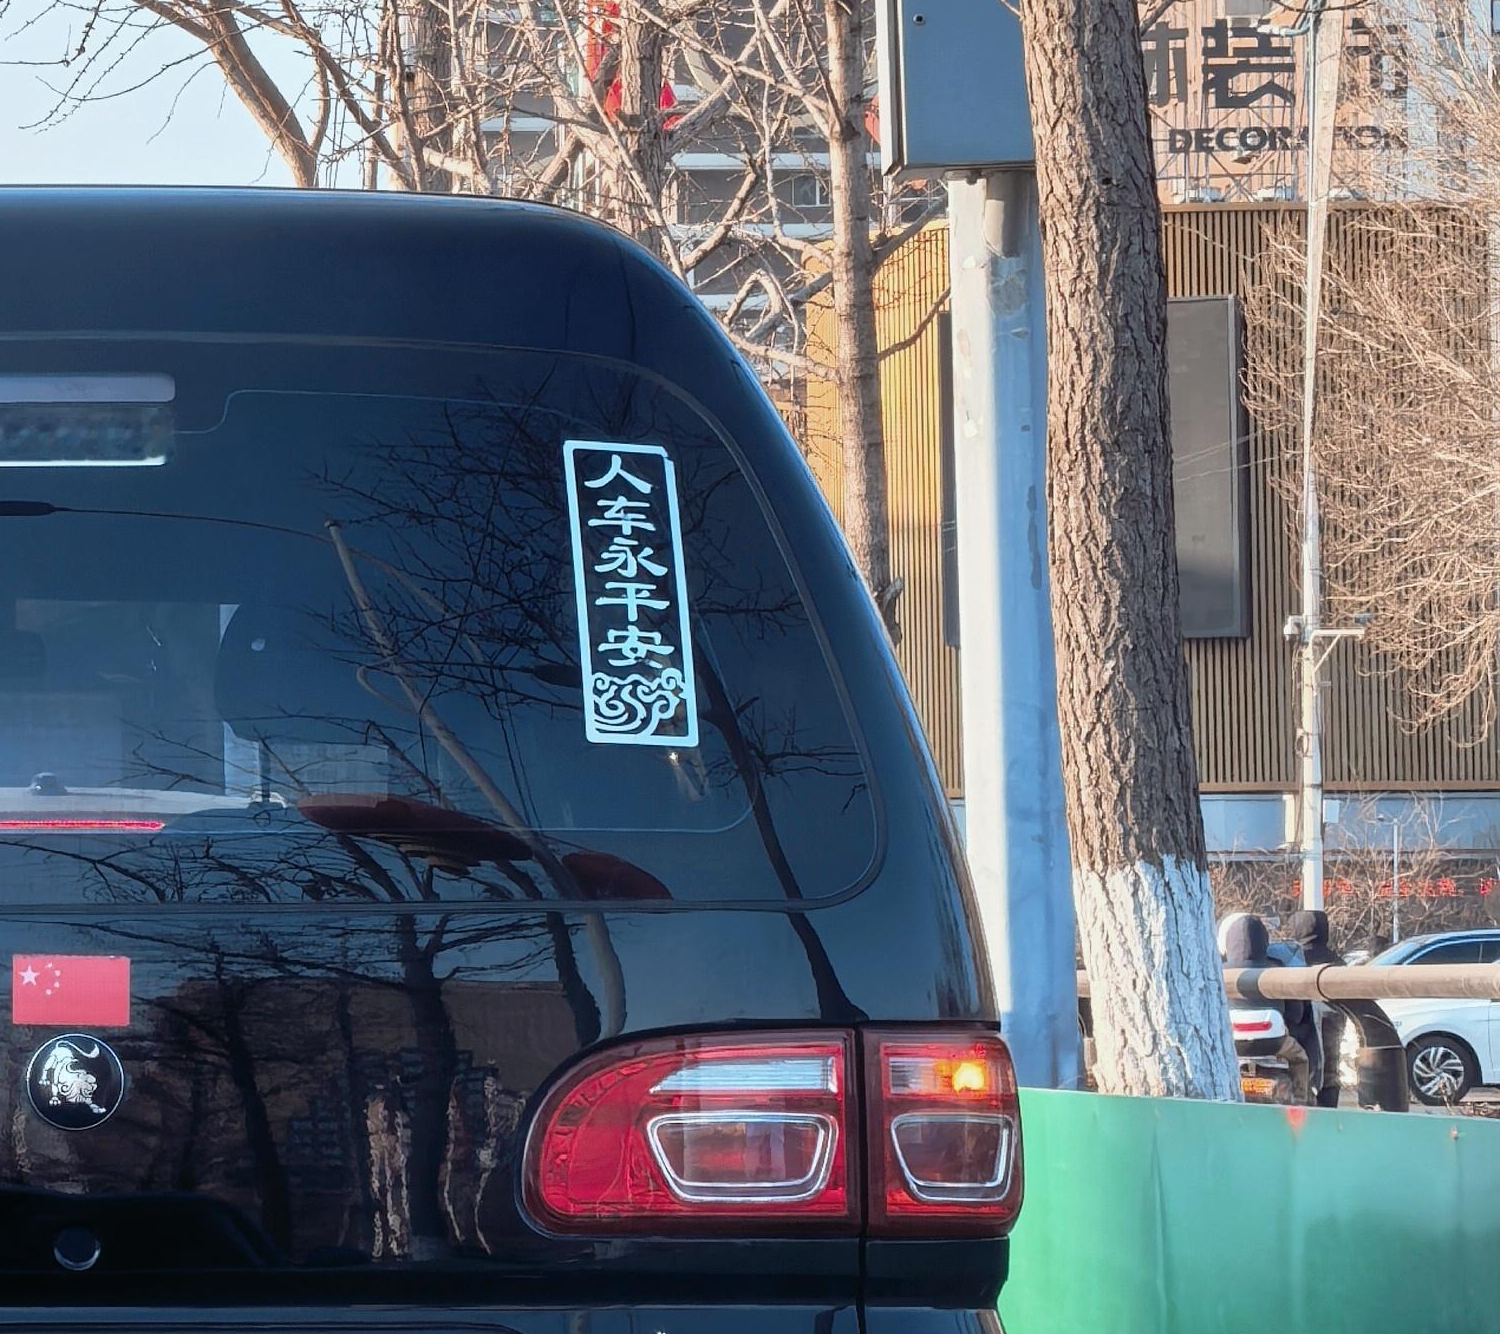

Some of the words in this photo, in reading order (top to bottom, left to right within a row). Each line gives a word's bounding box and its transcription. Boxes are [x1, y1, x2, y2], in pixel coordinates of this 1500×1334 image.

[584, 454, 675, 669] 人车永平安
